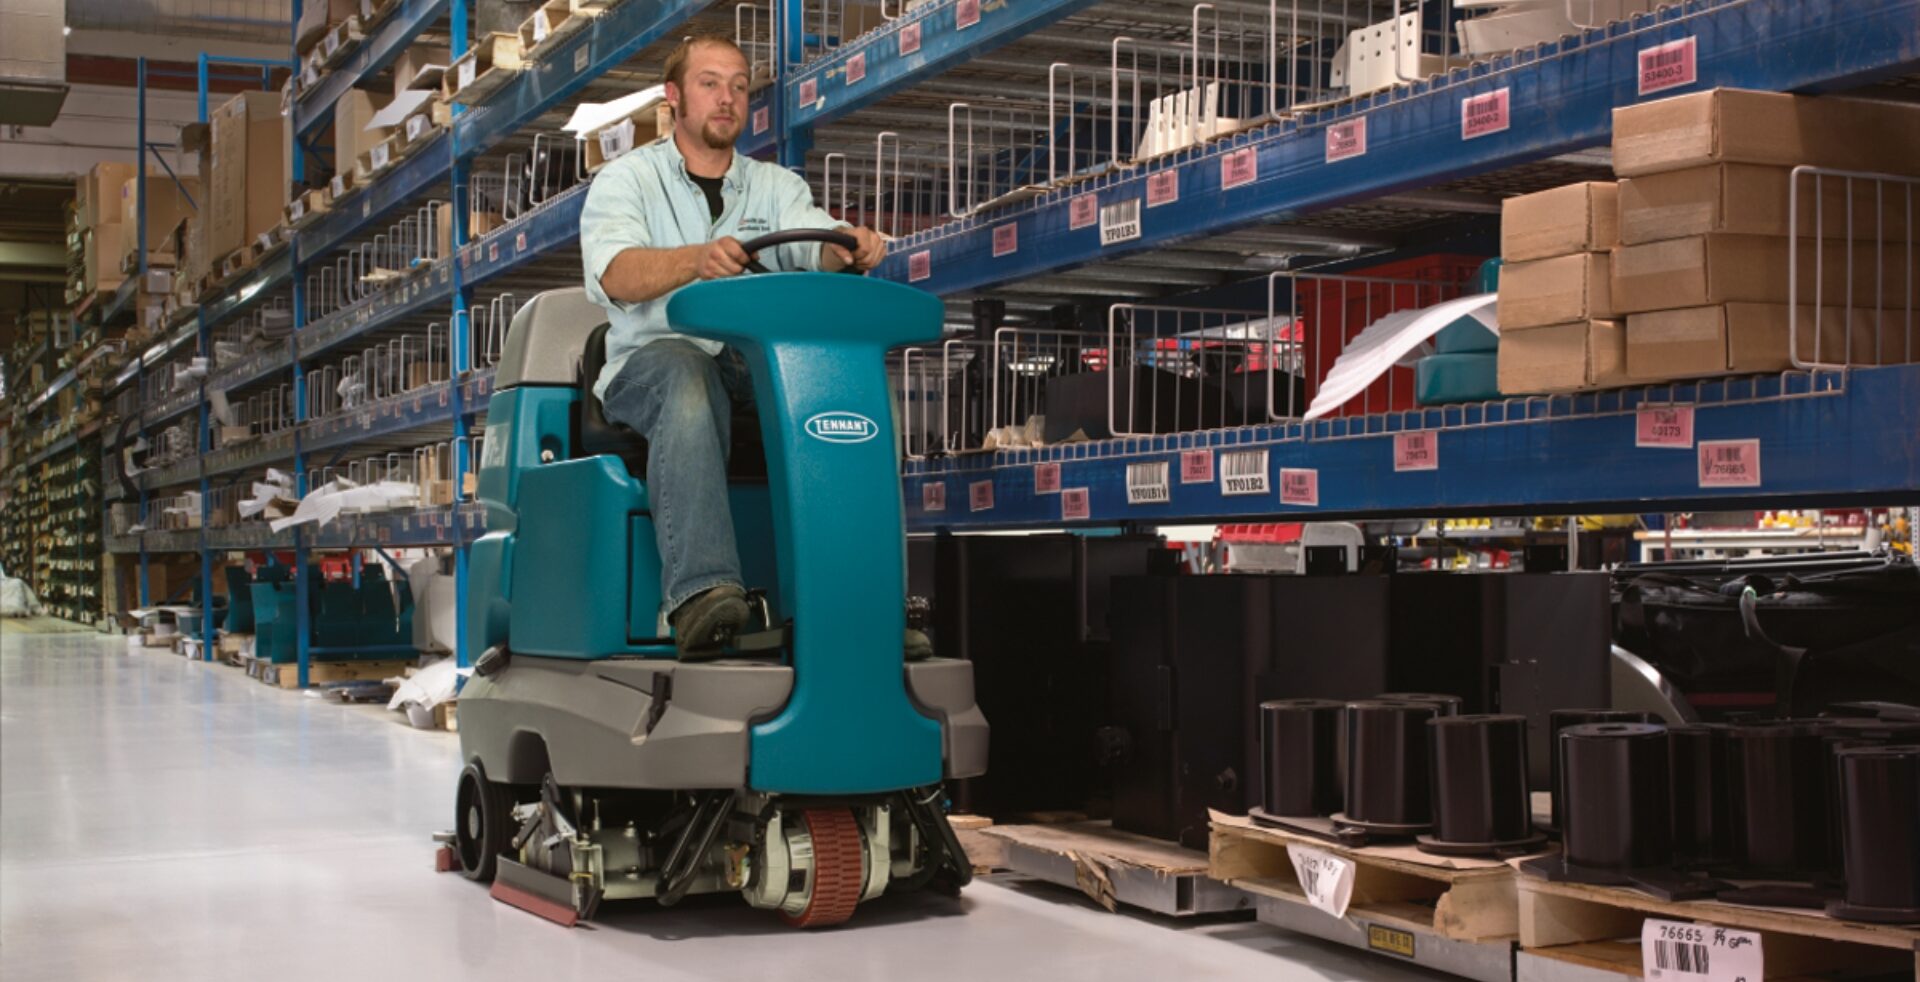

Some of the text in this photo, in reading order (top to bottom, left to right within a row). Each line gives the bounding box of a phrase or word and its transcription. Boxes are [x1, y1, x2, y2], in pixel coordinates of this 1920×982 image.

[814, 419, 869, 436] TENNANT
[1226, 477, 1265, 492] YF01B2
[1660, 926, 1704, 943] 76665
